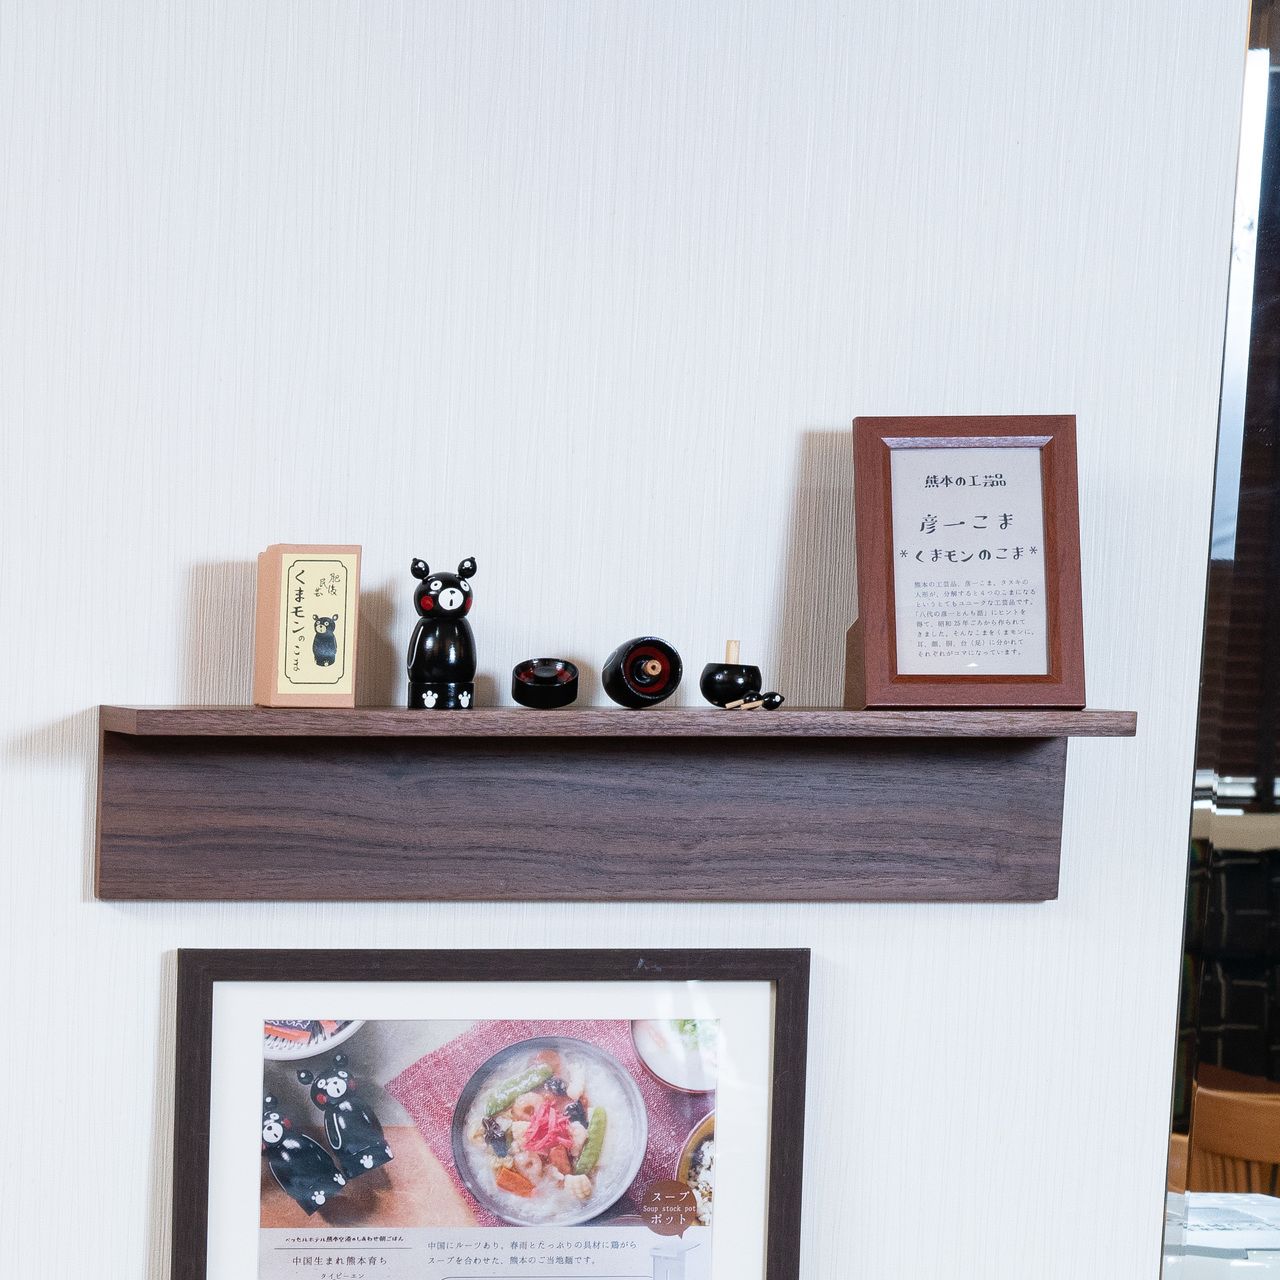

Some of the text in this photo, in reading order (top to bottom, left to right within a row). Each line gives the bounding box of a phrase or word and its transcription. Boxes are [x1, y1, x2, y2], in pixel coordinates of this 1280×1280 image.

[925, 474, 1007, 488] 熊本の工芸品
[919, 513, 1014, 534] 彦一こま
[651, 1191, 690, 1202] スープ
[643, 1204, 696, 1213] Soup stock pot
[651, 1214, 686, 1225] ポット
[292, 1256, 387, 1266] 中国生まれ熊本育ち
